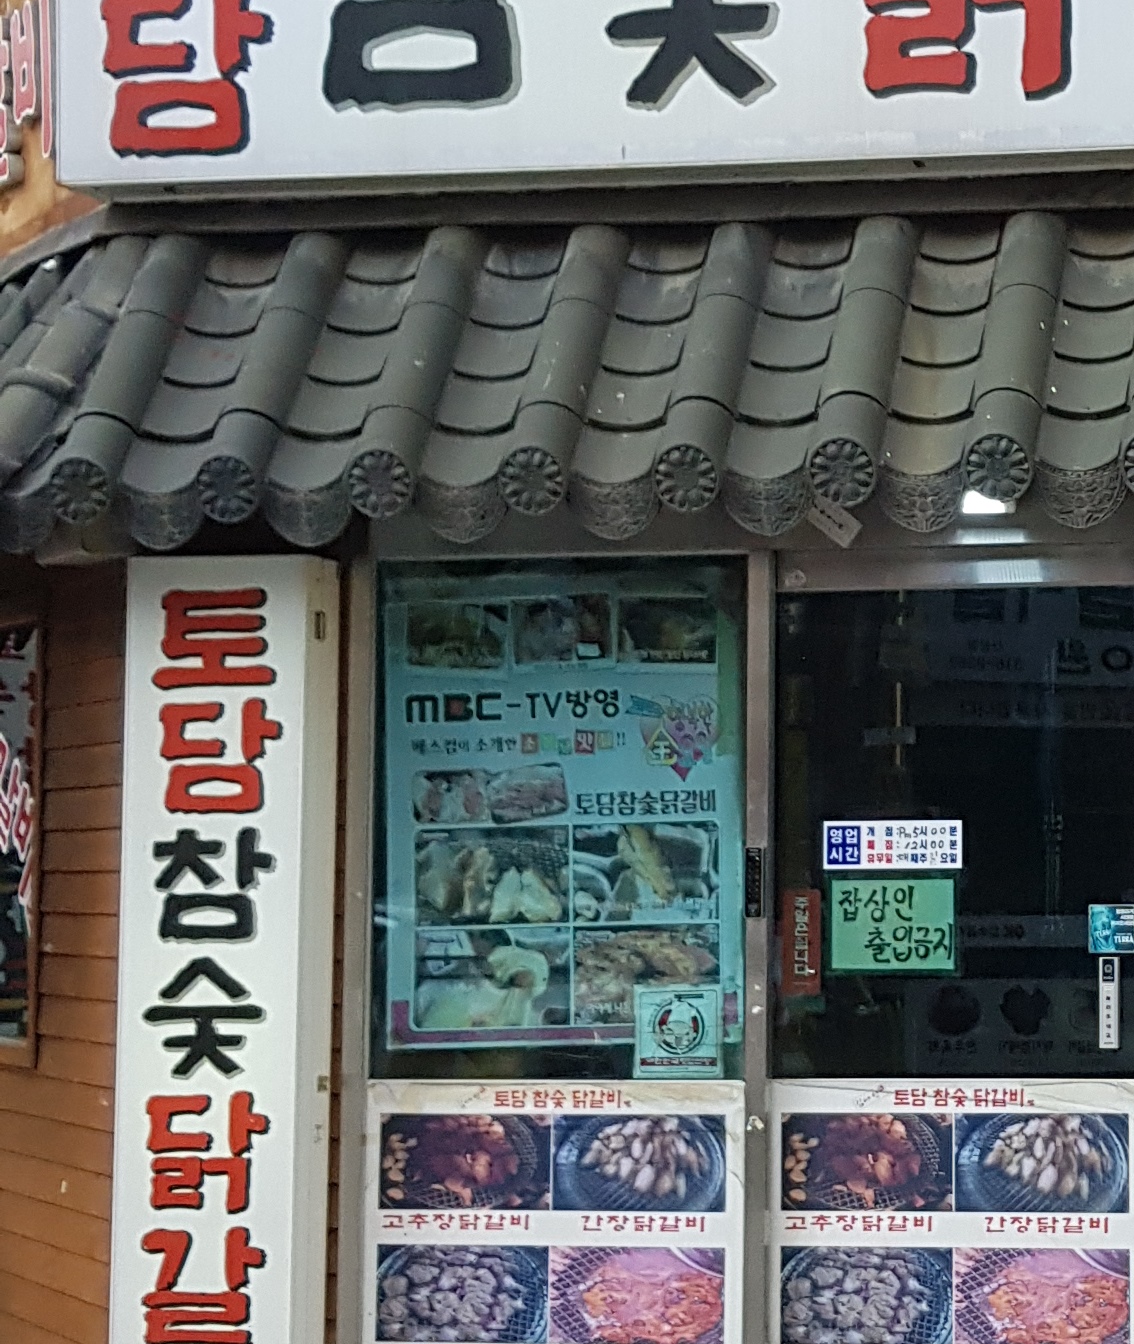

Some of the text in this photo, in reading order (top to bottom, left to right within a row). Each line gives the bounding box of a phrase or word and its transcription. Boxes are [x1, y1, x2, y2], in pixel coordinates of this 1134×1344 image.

[575, 789, 716, 816] 토담참숯닭갈비
[829, 828, 858, 844] 영업
[829, 847, 859, 862] 시간
[838, 885, 915, 923] 잡상인
[864, 922, 954, 963] 출입금지
[382, 1213, 530, 1231] 고추장닭갈비
[581, 1214, 706, 1233] 간장닭갈비
[785, 1214, 933, 1233] 고추장닭갈비
[984, 1215, 1110, 1235] 간장닭갈비
